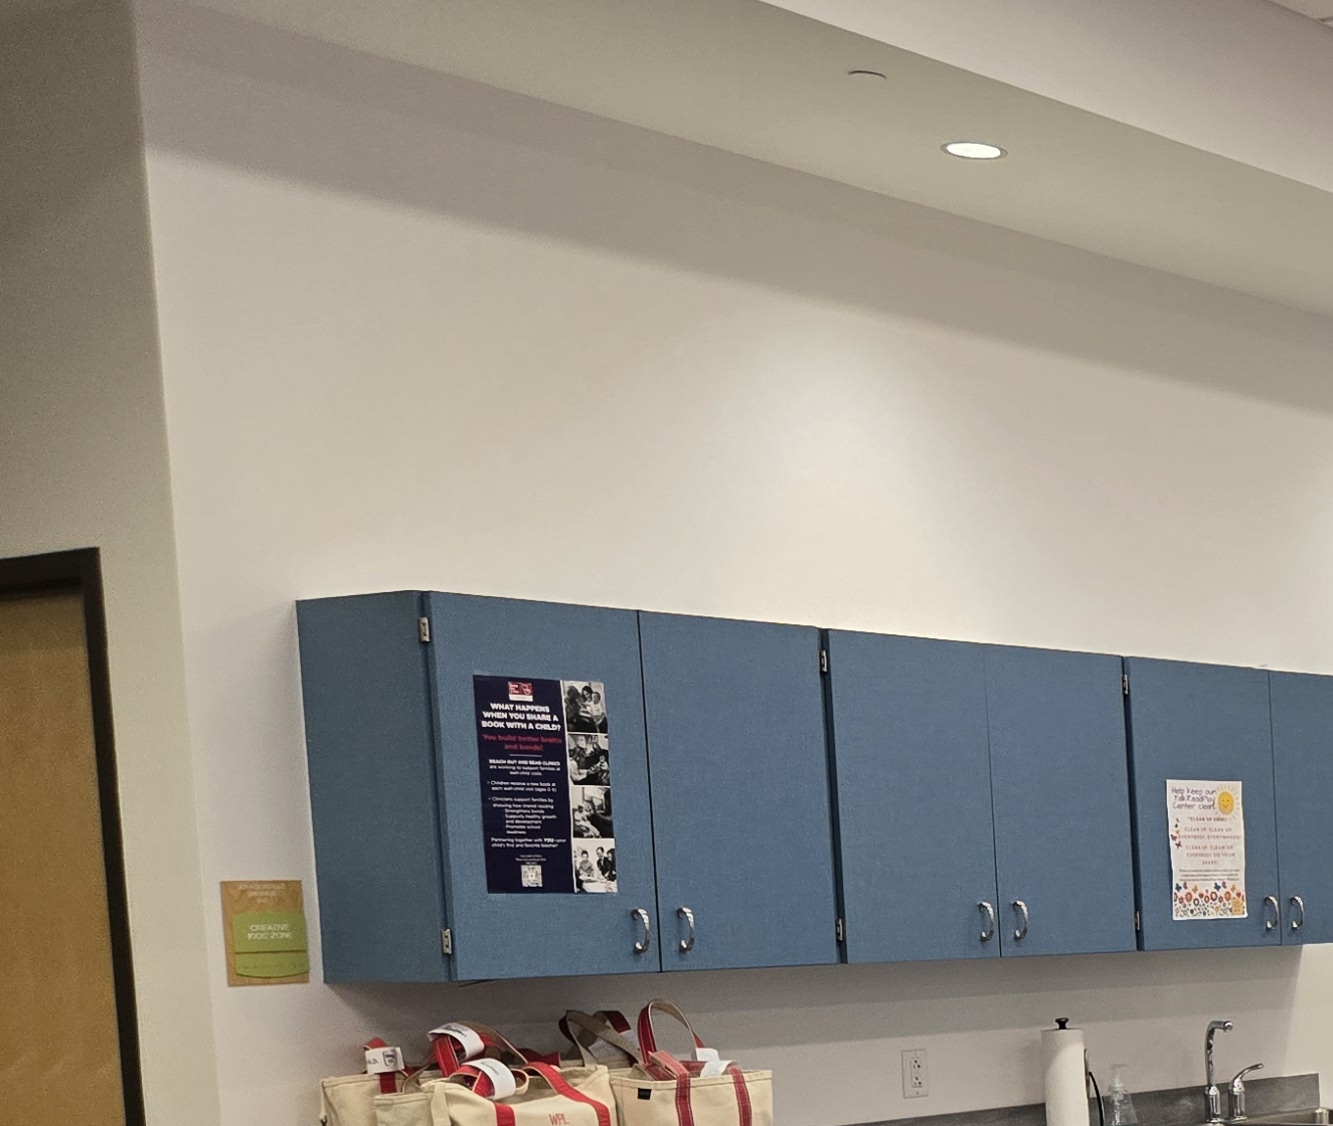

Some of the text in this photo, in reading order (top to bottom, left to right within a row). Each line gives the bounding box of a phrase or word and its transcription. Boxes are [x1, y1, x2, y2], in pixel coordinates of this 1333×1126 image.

[516, 704, 550, 713] HAPPENS
[482, 711, 507, 719] WHEN
[509, 712, 525, 720] YOU
[481, 721, 505, 729] BOOK
[506, 722, 527, 730] WITH
[549, 1113, 570, 1125] WPL
